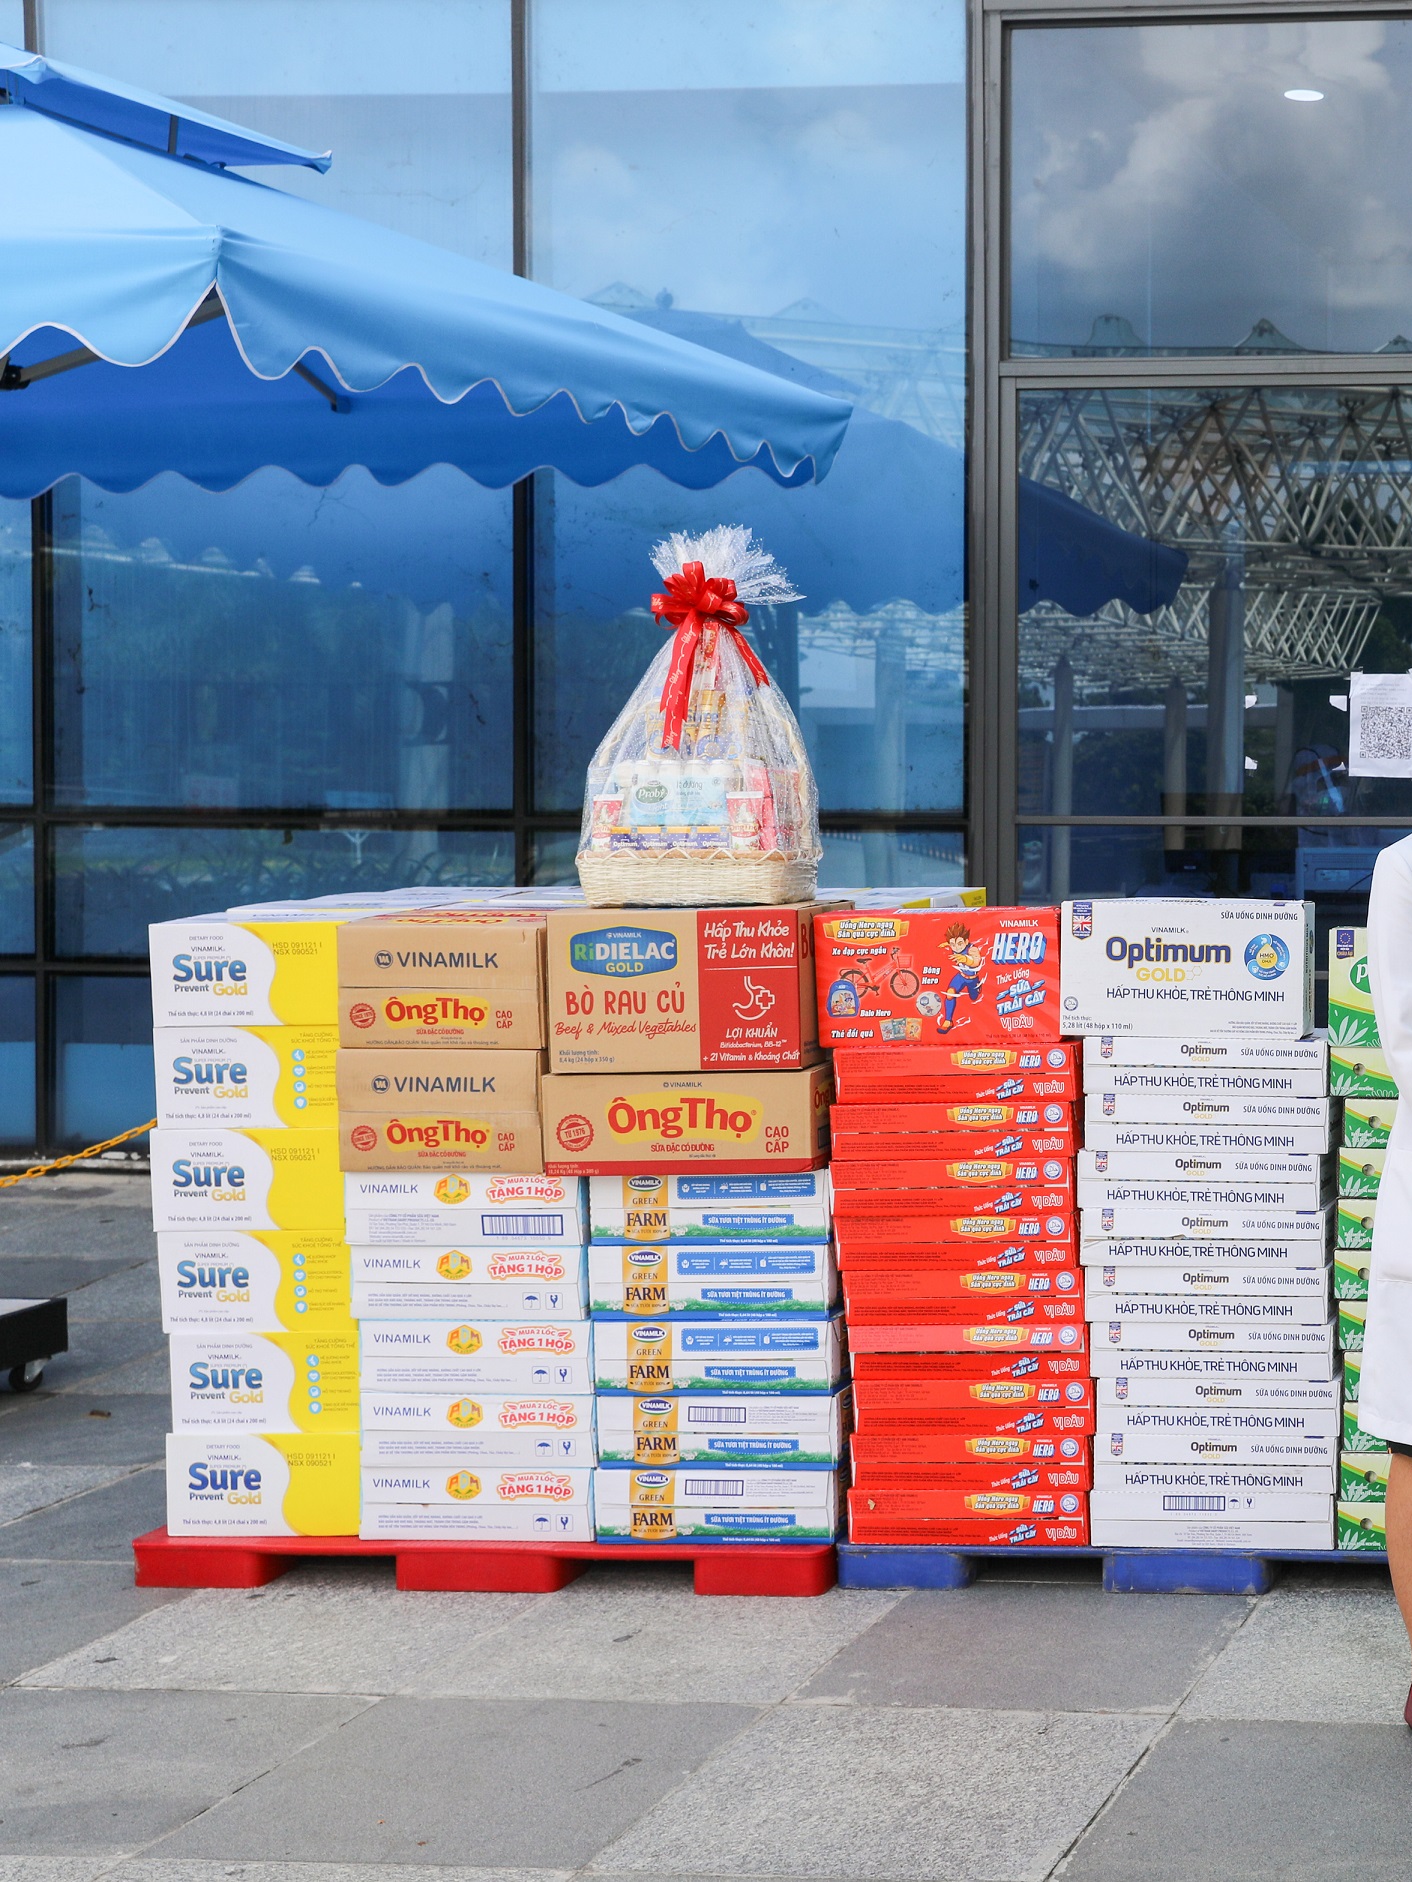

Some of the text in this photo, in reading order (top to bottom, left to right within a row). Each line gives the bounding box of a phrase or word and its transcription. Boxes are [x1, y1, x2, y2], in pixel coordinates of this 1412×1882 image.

[704, 920, 790, 941] Hấp Thu Khỏe
[704, 941, 727, 959] Trẻ
[731, 941, 756, 959] Lớn
[991, 931, 1045, 961] HERO
[1106, 936, 1232, 969] Optimum
[397, 952, 499, 969] VINAMILK
[172, 954, 247, 982] Sure
[605, 962, 644, 973] GOLD
[1136, 967, 1186, 982] GOLD
[174, 982, 248, 996] Prevent Gold
[566, 982, 685, 1016] BÒ RAU CỦ
[1255, 991, 1285, 1002] MINH
[495, 1011, 513, 1020] CAO
[555, 1018, 697, 1040] Beef & Mixed Vegetables
[710, 1052, 718, 1061] 21
[719, 1052, 747, 1062] Vitamin
[1181, 1044, 1227, 1057] Optimum
[394, 1076, 496, 1093] VINAMILK
[497, 1132, 515, 1142] CAO
[765, 1125, 789, 1138] CAO
[765, 1136, 789, 1153] CẤP
[172, 1159, 245, 1187] Sure
[173, 1189, 246, 1201] Prevent Gold
[360, 1184, 418, 1194] VINAMILK
[627, 1212, 667, 1226] FARM
[1182, 1217, 1228, 1229] Optimum
[364, 1259, 421, 1269] VINAMILK
[626, 1287, 666, 1300] FARM
[1195, 1385, 1242, 1397] Optimum
[188, 1462, 261, 1491] Sure
[372, 1478, 430, 1488] VINAMILK
[189, 1492, 262, 1505] Prevent Gold
[633, 1513, 673, 1526] FARM
